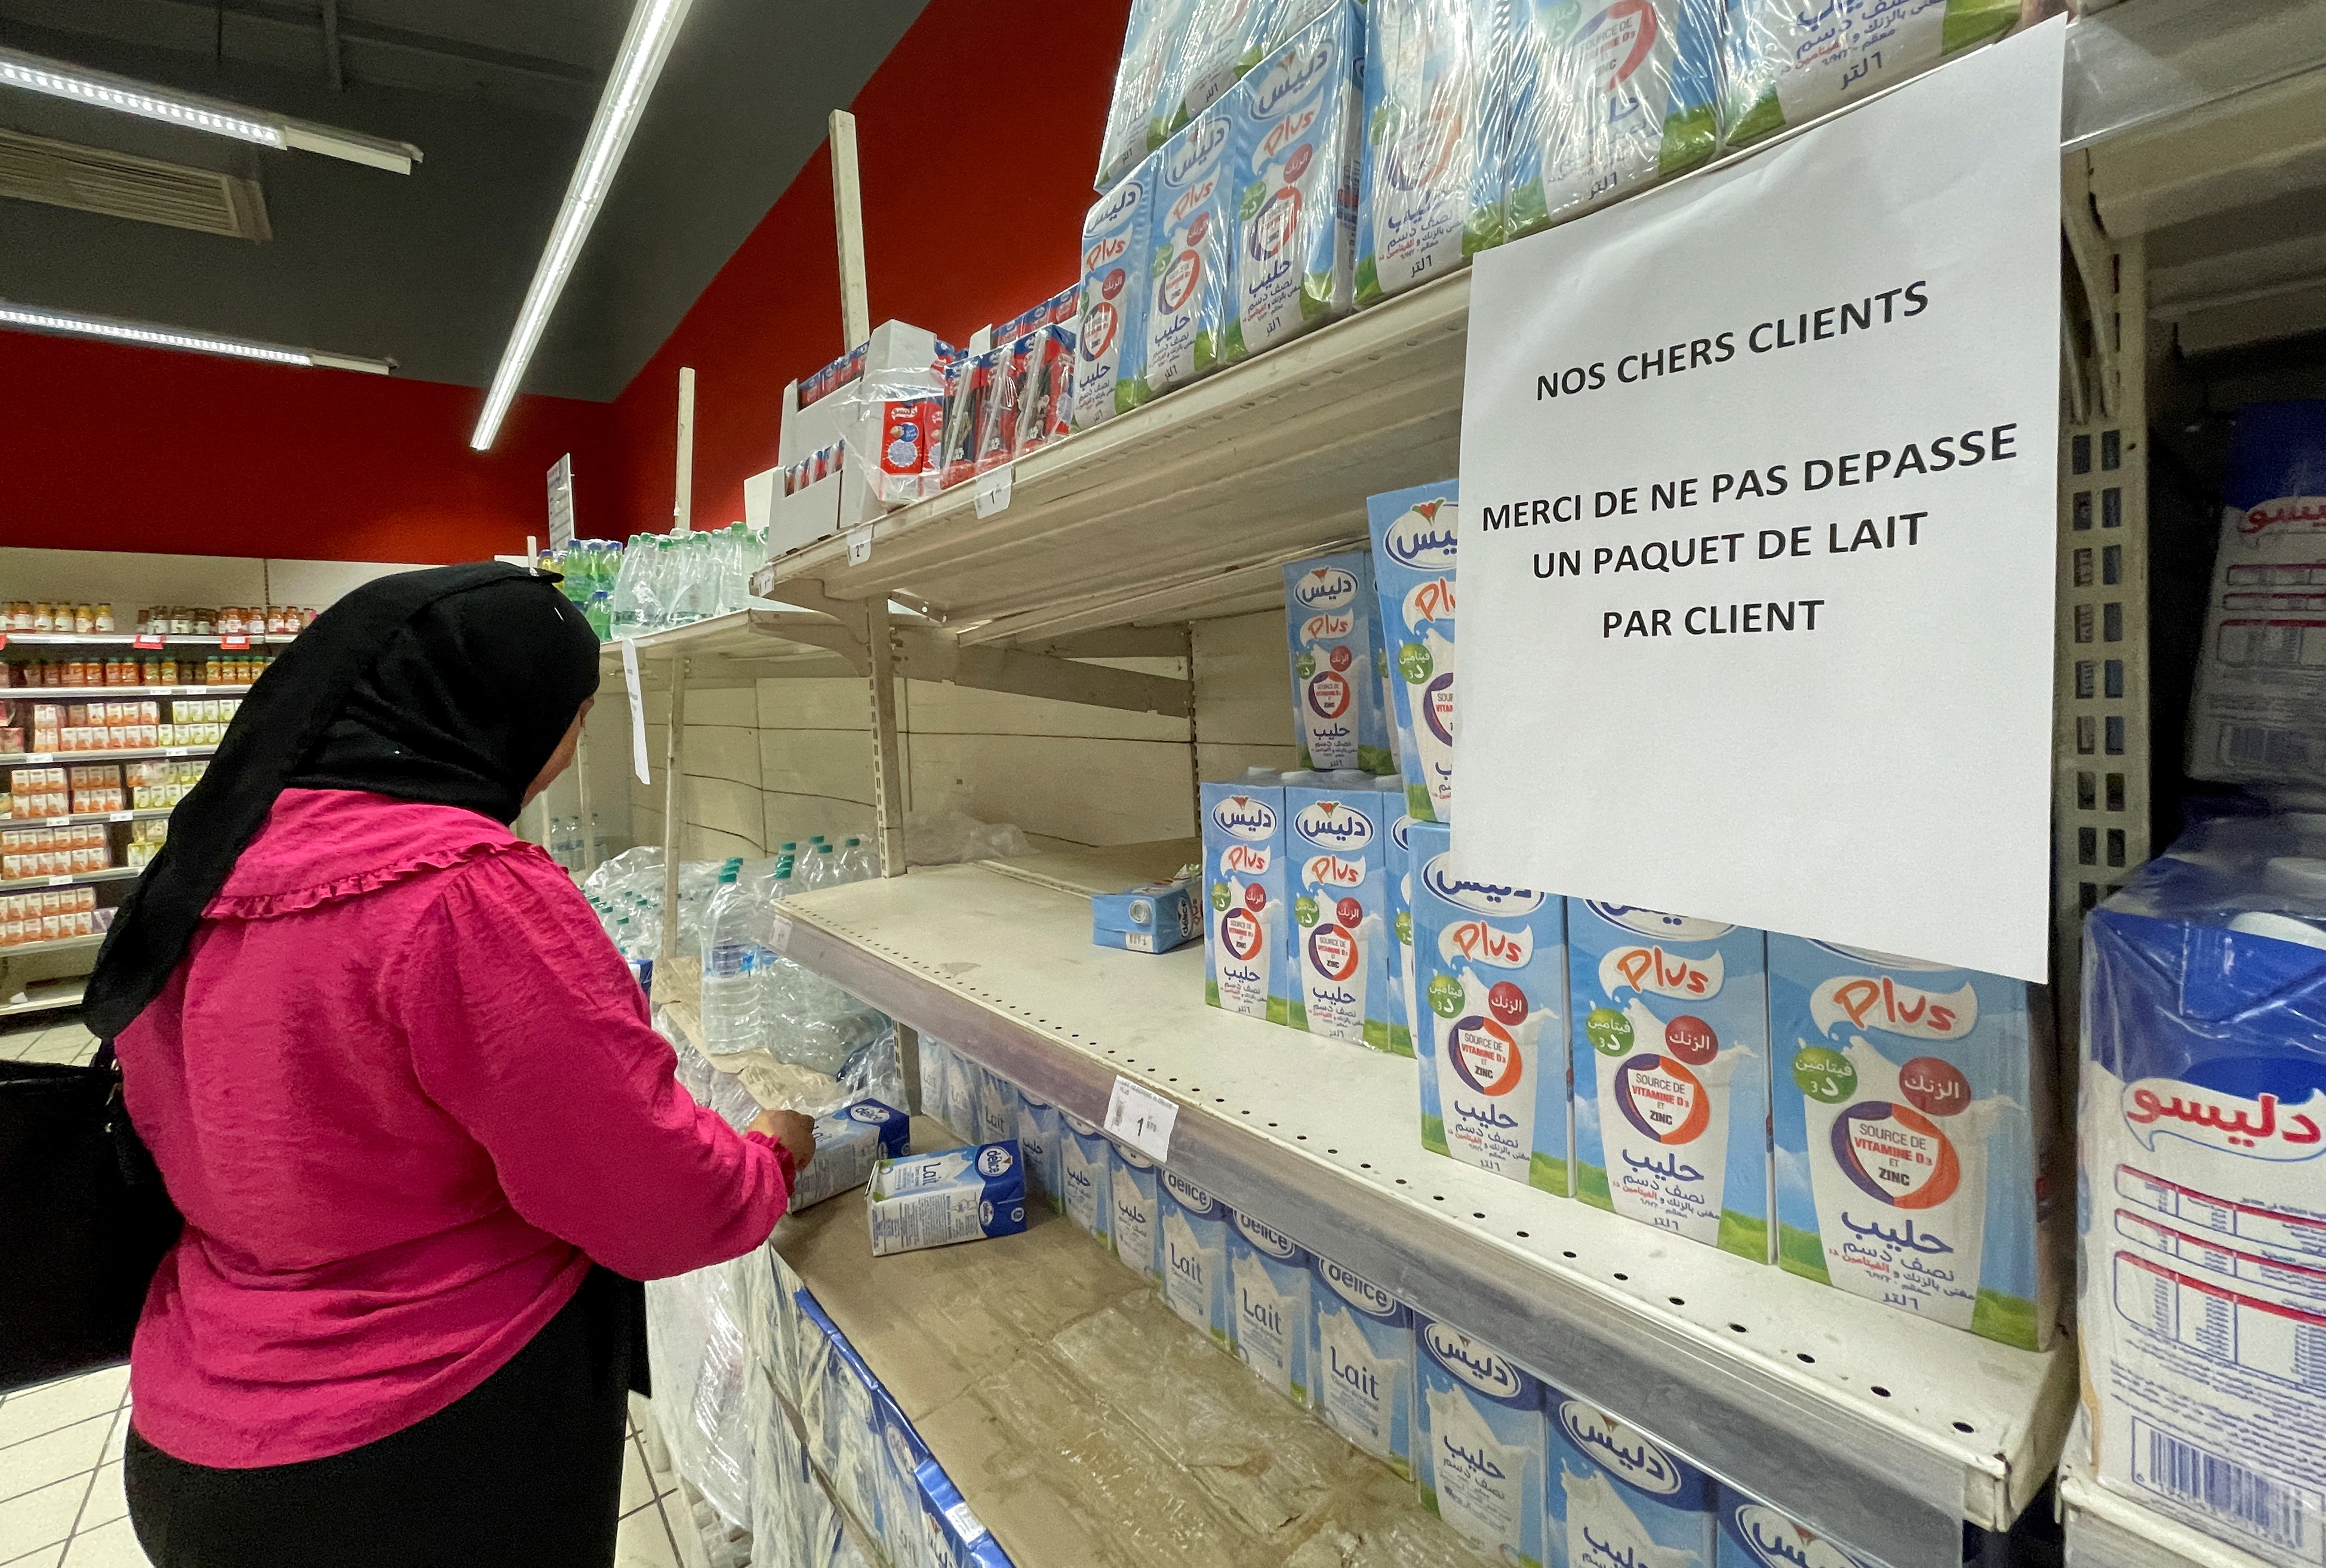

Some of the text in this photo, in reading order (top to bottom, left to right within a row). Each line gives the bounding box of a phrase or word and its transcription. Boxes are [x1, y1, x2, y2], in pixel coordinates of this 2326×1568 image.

[1258, 50, 1328, 115] دليس
[1263, 110, 1315, 157] Plus
[1171, 127, 1225, 184] دليس
[1086, 188, 1137, 235] دليس
[1173, 181, 1214, 221] Plus
[1086, 238, 1126, 272] Plus
[1154, 314, 1190, 344] حليب
[1537, 281, 1928, 401] NOS CHERS CLIENTS
[1078, 362, 1111, 390] حليب
[1483, 423, 2017, 531] MERCI DE NE PAS DEPASSE
[1396, 529, 1458, 560] يس
[1534, 512, 1928, 578] UN PAQUET DE LAIT
[1302, 576, 1352, 603] دليس
[1414, 577, 1456, 623] Pl
[1307, 613, 1348, 639] Plus
[1604, 600, 1825, 638] PAR CLIENT
[1313, 722, 1350, 740] حليب
[1220, 809, 1272, 832] دليس
[1303, 816, 1366, 842] دليس
[1228, 845, 1265, 871] Plus
[1310, 855, 1359, 885] Plus
[1337, 907, 1360, 920] الزنك
[1452, 921, 1522, 963] Plus
[1223, 965, 1261, 984] حليب
[1617, 947, 1709, 994] Plus
[1312, 985, 1356, 1006] حليب
[1429, 984, 1463, 999] فيتامين
[1833, 977, 1956, 1031] Plus
[1491, 995, 1522, 1015] الزنك
[1587, 1018, 1631, 1035] فيتامين
[1461, 1043, 1495, 1061] VITAMINE
[1464, 1033, 1503, 1053] SOURCE DE
[1669, 1031, 1710, 1052] الزنك
[1475, 1065, 1494, 1079] ZINC
[1795, 1058, 1853, 1078] فيتامين
[1631, 1085, 1675, 1105] VITAMINE
[1636, 1073, 1686, 1095] SOURCE DE
[1904, 1075, 1960, 1101] الزنك
[1454, 1100, 1519, 1129] حليب
[1650, 1110, 1673, 1126] ZINC
[1657, 1101, 1664, 1110] ET
[2125, 1089, 2322, 1148] دليسو
[985, 1110, 1005, 1133] Lait
[1137, 1117, 1144, 1137] 1
[1455, 1123, 1519, 1149] نصف دسم
[1853, 1136, 1913, 1162] VITAMINE
[1859, 1123, 1927, 1151] SOURCE DE
[922, 1161, 942, 1187] Lait
[1622, 1148, 1705, 1181] حليب
[1889, 1158, 1900, 1167] ET
[1067, 1166, 1091, 1187] حليب
[1623, 1174, 1705, 1205] نصف دسم
[1878, 1167, 1910, 1187] ZINC
[1622, 1184, 1657, 1201] الفيتامين
[1118, 1200, 1147, 1224] حليب
[1666, 1198, 1694, 1214] بالزنك
[1841, 1211, 1953, 1254] حليب
[1170, 1242, 1204, 1285] Lait
[1841, 1255, 1891, 1273] الفيتامين
[1842, 1242, 1955, 1281] نصف دسم
[1893, 1270, 1900, 1279] و
[1903, 1271, 1940, 1292] بالزنك
[1242, 1287, 1282, 1336] Lait
[1882, 1292, 1919, 1311] 1 لتر
[1330, 1345, 1380, 1401] Lait
[1434, 1335, 1509, 1387] دليس
[1443, 1434, 1506, 1480] حليب
[1571, 1414, 1666, 1481] دليس
[1443, 1458, 1472, 1480] دسم
